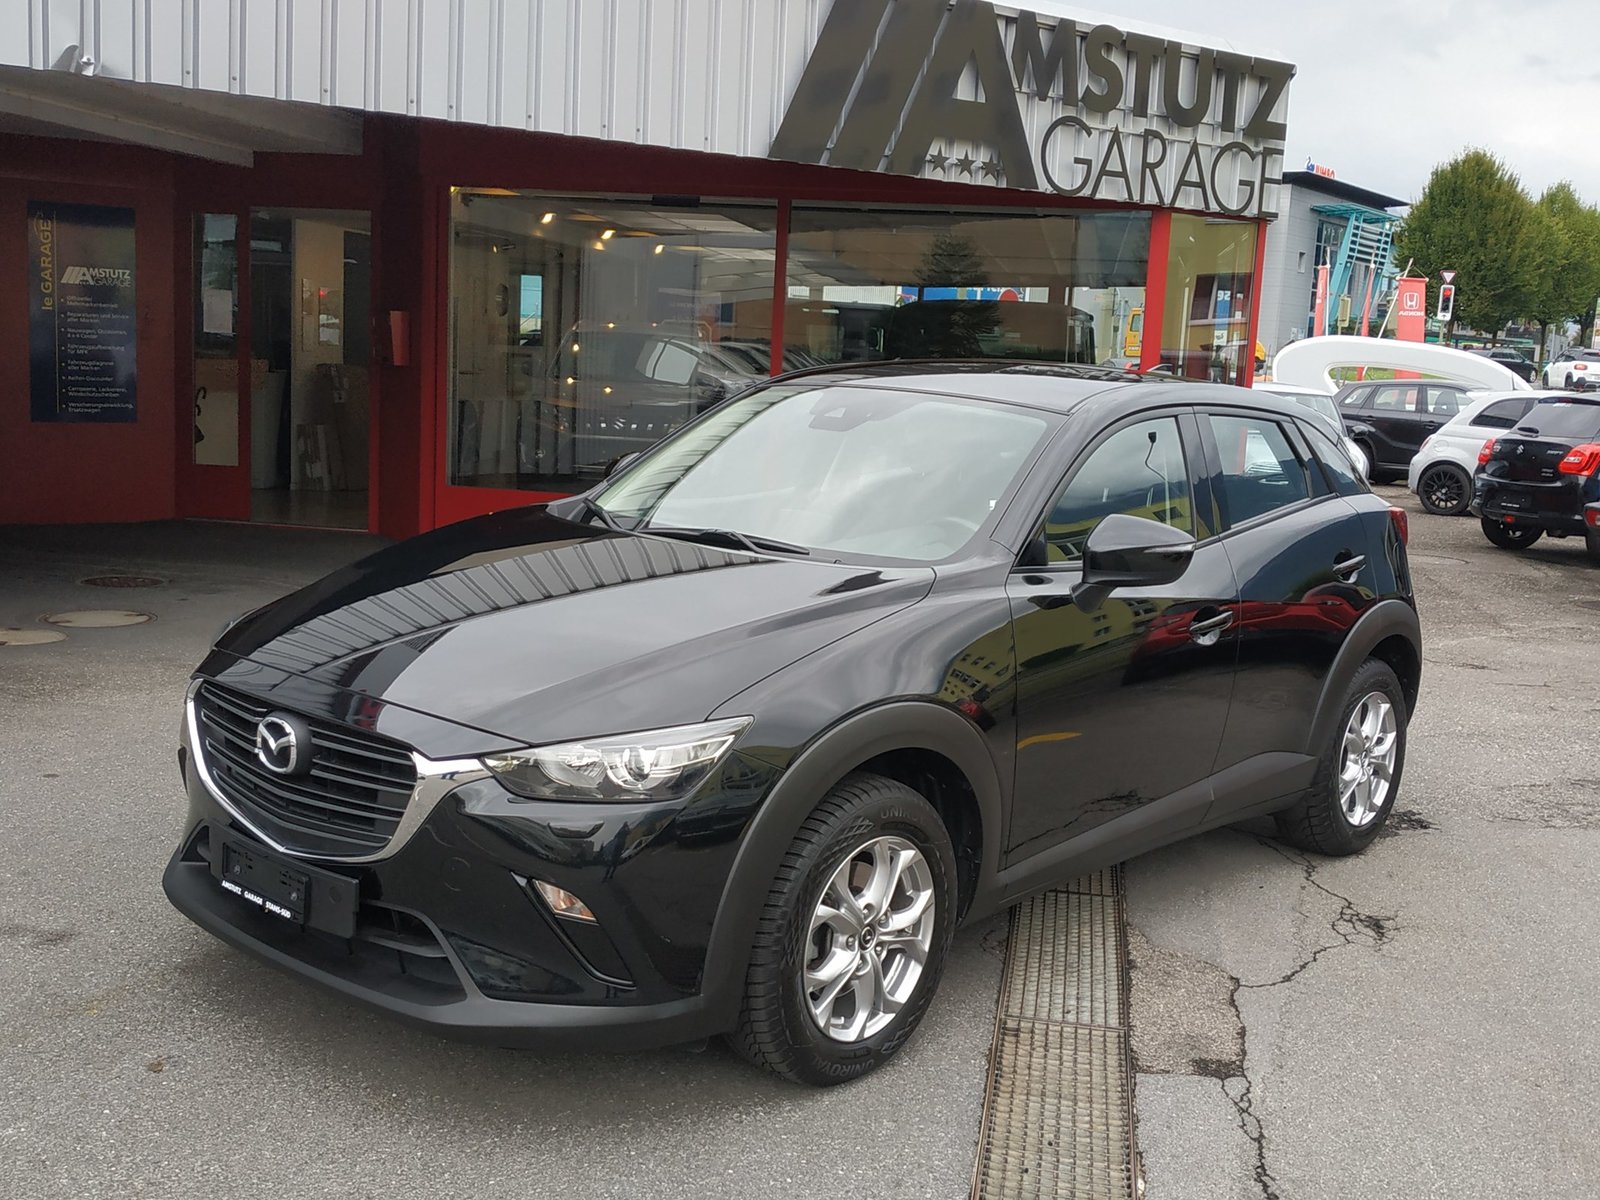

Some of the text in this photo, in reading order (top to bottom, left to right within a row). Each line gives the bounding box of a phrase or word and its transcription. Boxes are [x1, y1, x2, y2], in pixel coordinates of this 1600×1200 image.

[875, 0, 1297, 190] AMSTUTZ
[1040, 114, 1284, 219] GARAGE
[40, 219, 52, 293] GARAGE
[75, 266, 131, 285] AMSTUTZ
[93, 277, 132, 288] GARAGE
[244, 890, 263, 905] GARAGE
